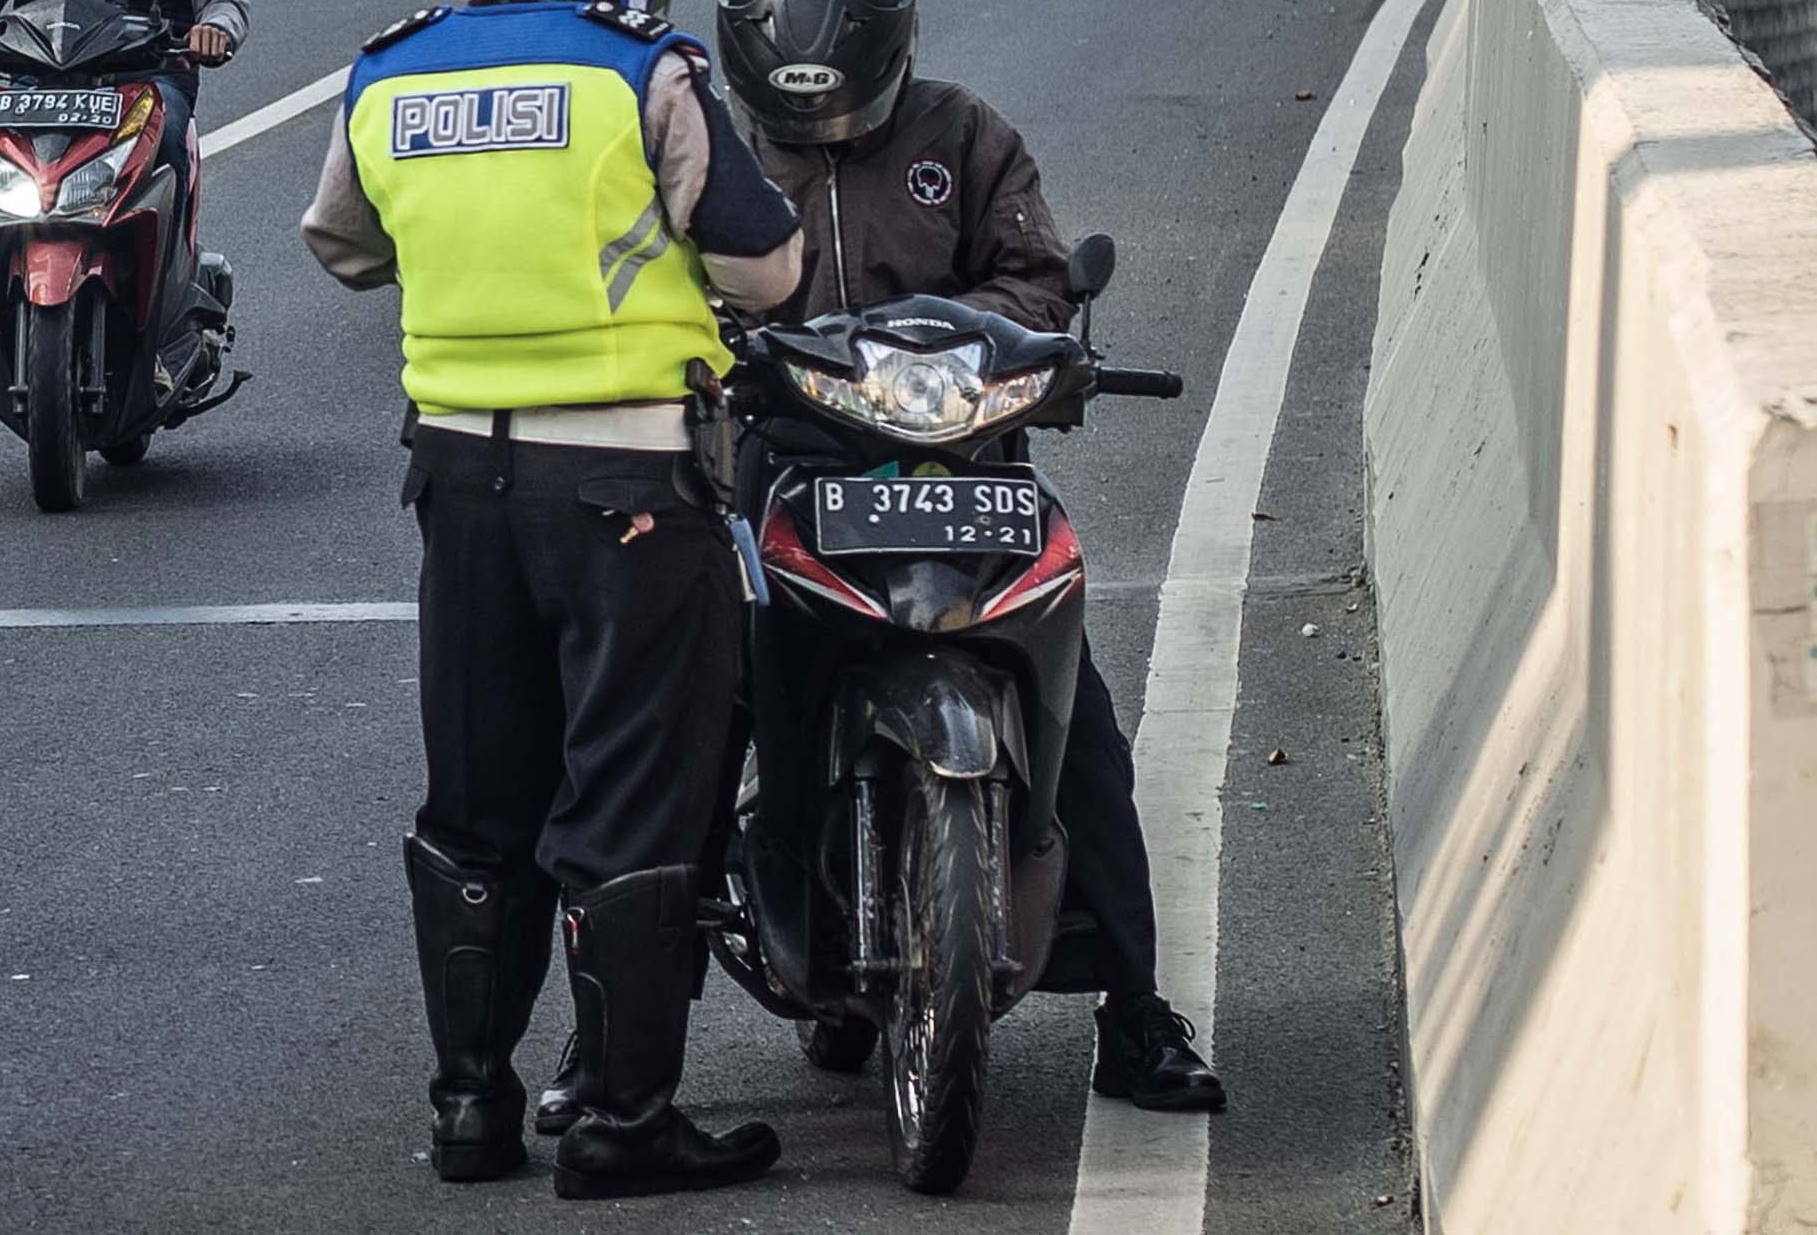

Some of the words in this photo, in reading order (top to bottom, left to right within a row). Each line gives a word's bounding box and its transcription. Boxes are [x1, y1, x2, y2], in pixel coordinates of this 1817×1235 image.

[396, 87, 561, 150] POLISI
[824, 482, 844, 511] B
[873, 483, 954, 513] 3743
[974, 485, 1035, 516] SDS
